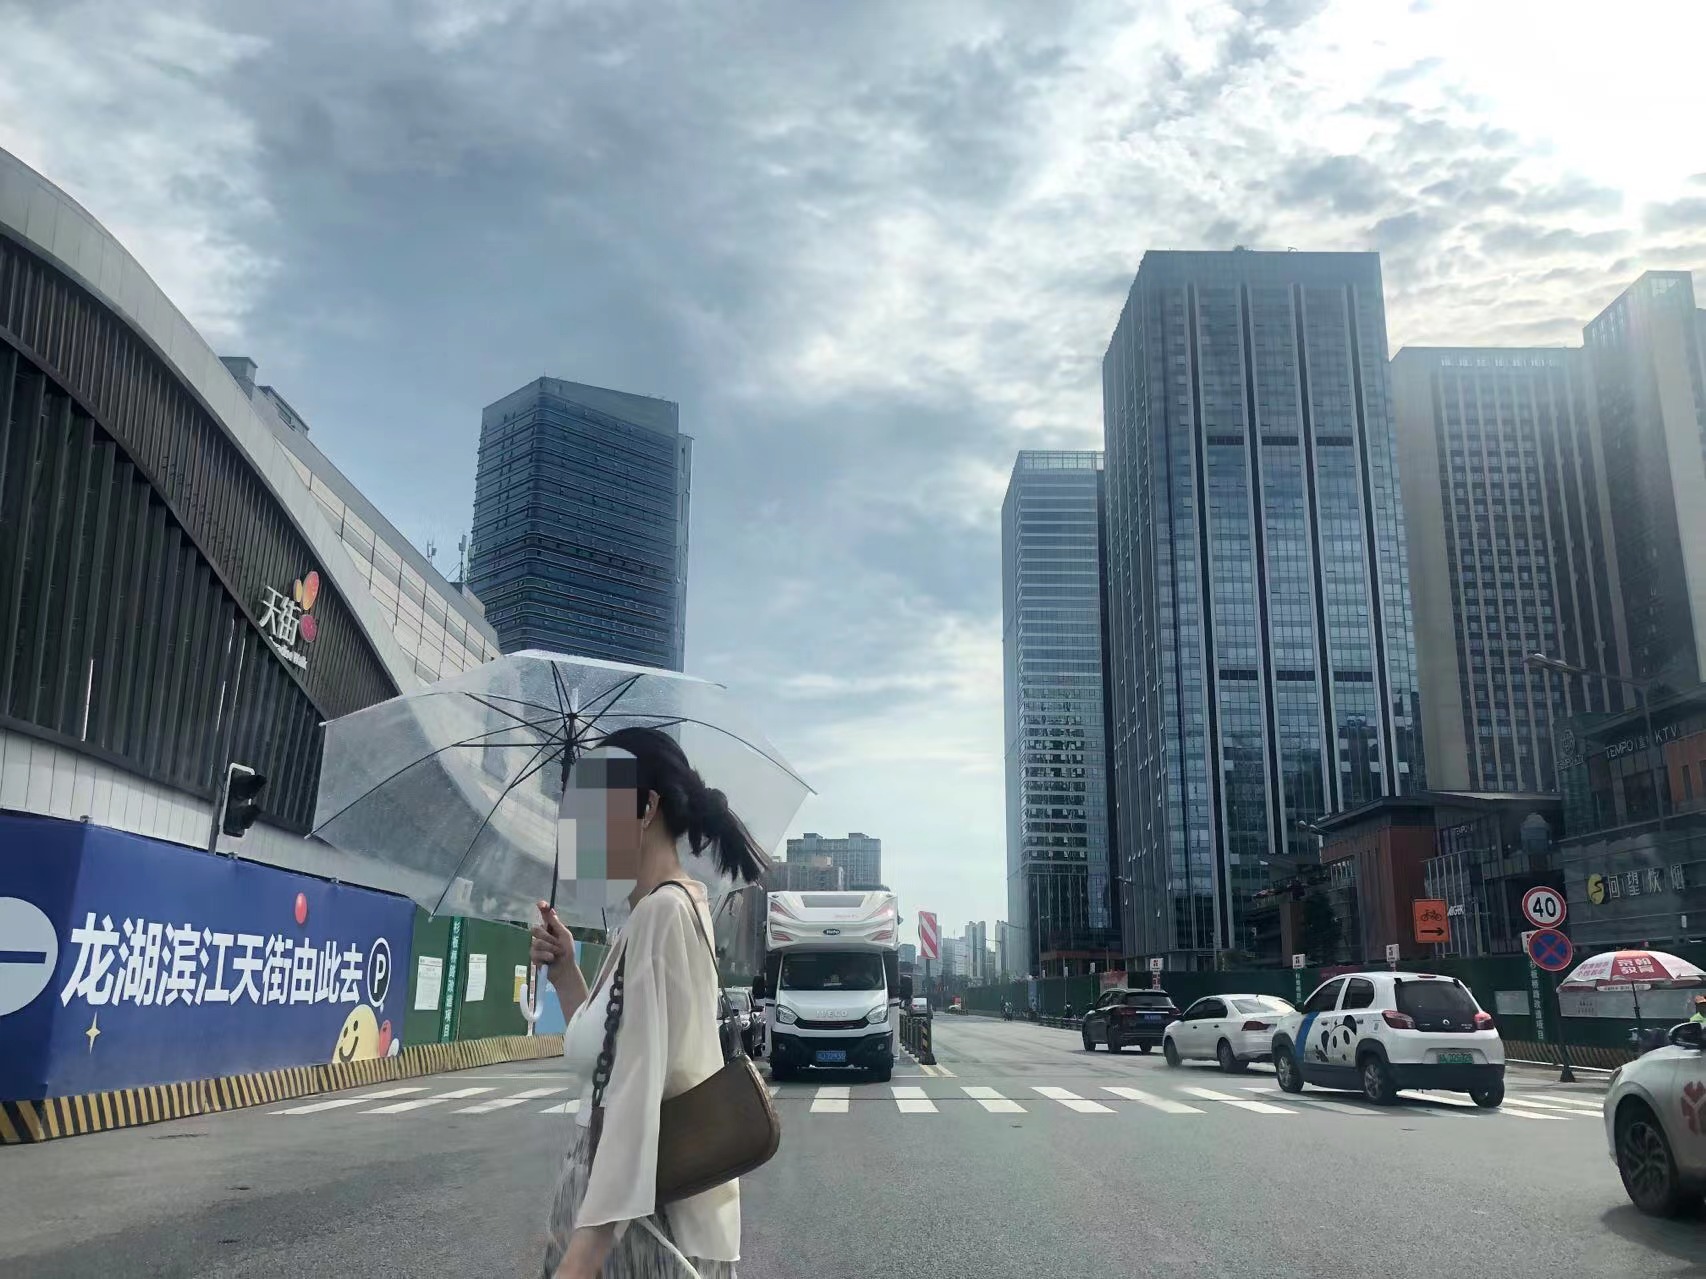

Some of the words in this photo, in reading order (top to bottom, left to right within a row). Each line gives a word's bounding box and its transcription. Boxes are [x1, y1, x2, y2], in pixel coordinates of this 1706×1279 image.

[258, 585, 302, 646] 天街
[1603, 739, 1634, 759] TEMPO
[1654, 724, 1678, 744] KTV
[1532, 896, 1557, 918] 40
[60, 911, 364, 1007] 龙湖滨江天街由此去
